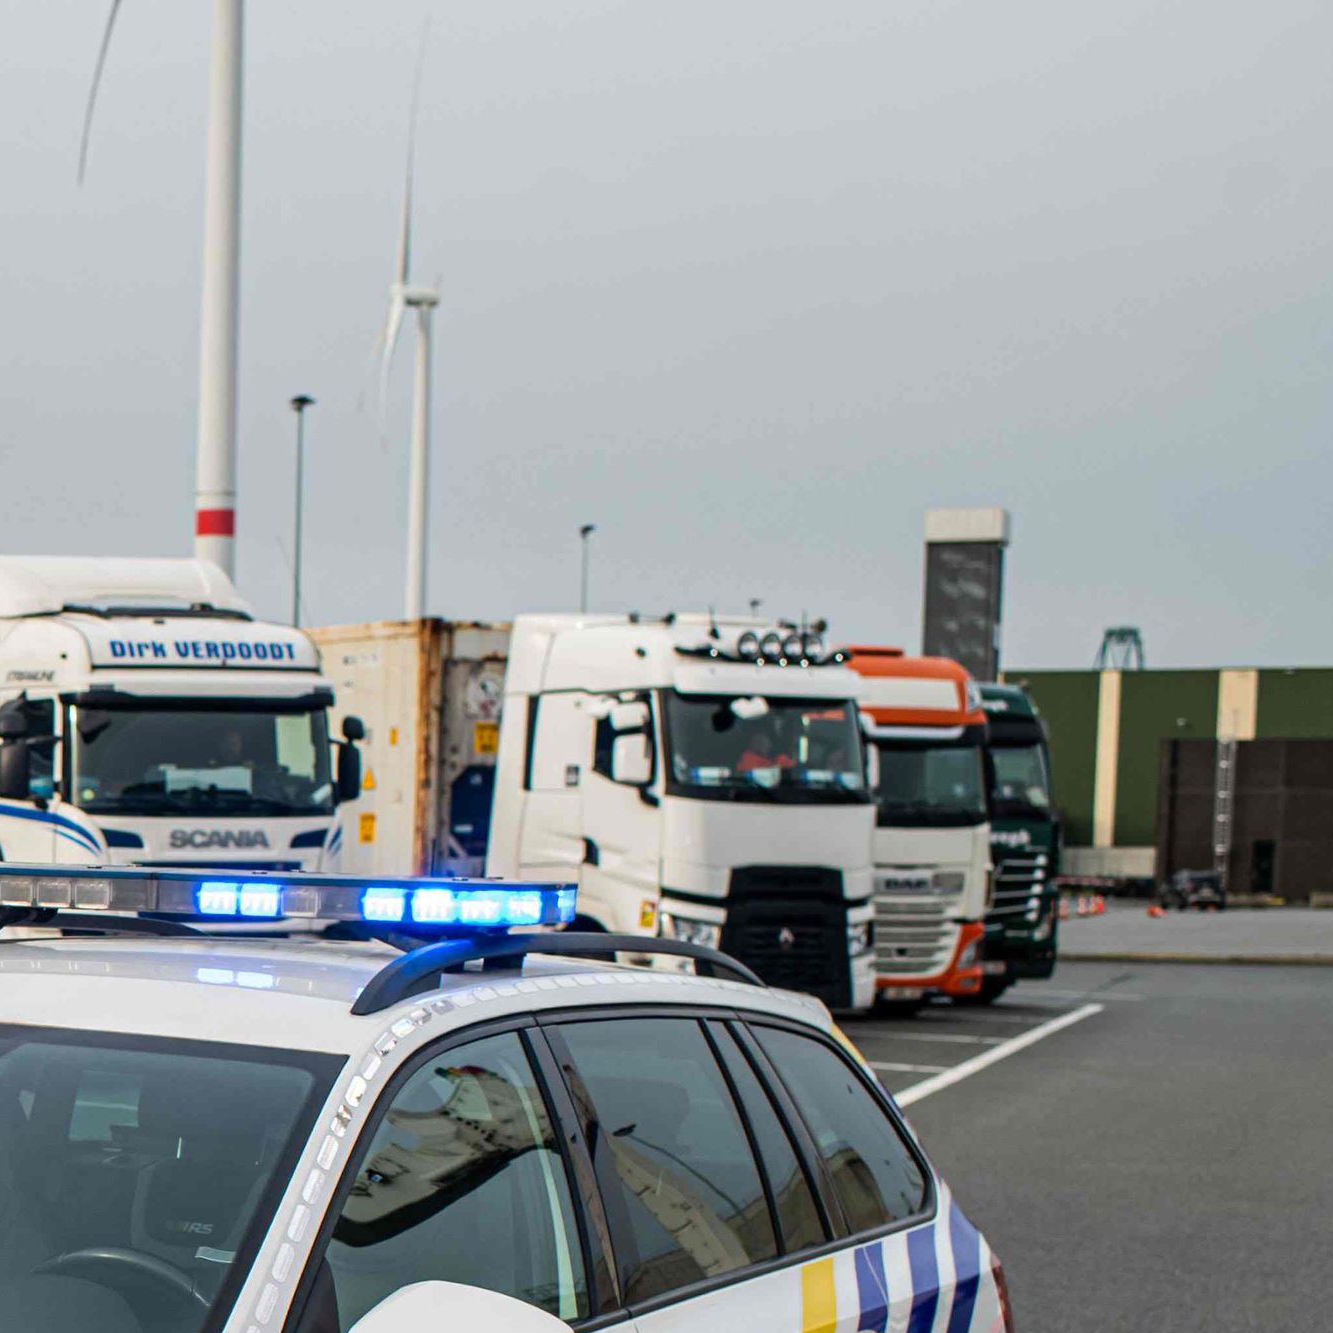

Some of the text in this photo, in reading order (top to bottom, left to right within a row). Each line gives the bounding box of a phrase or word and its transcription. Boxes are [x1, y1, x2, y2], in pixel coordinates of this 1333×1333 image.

[174, 640, 295, 660] VERDOODT
[170, 829, 269, 849] SCANIA
[884, 877, 930, 890] DAF
